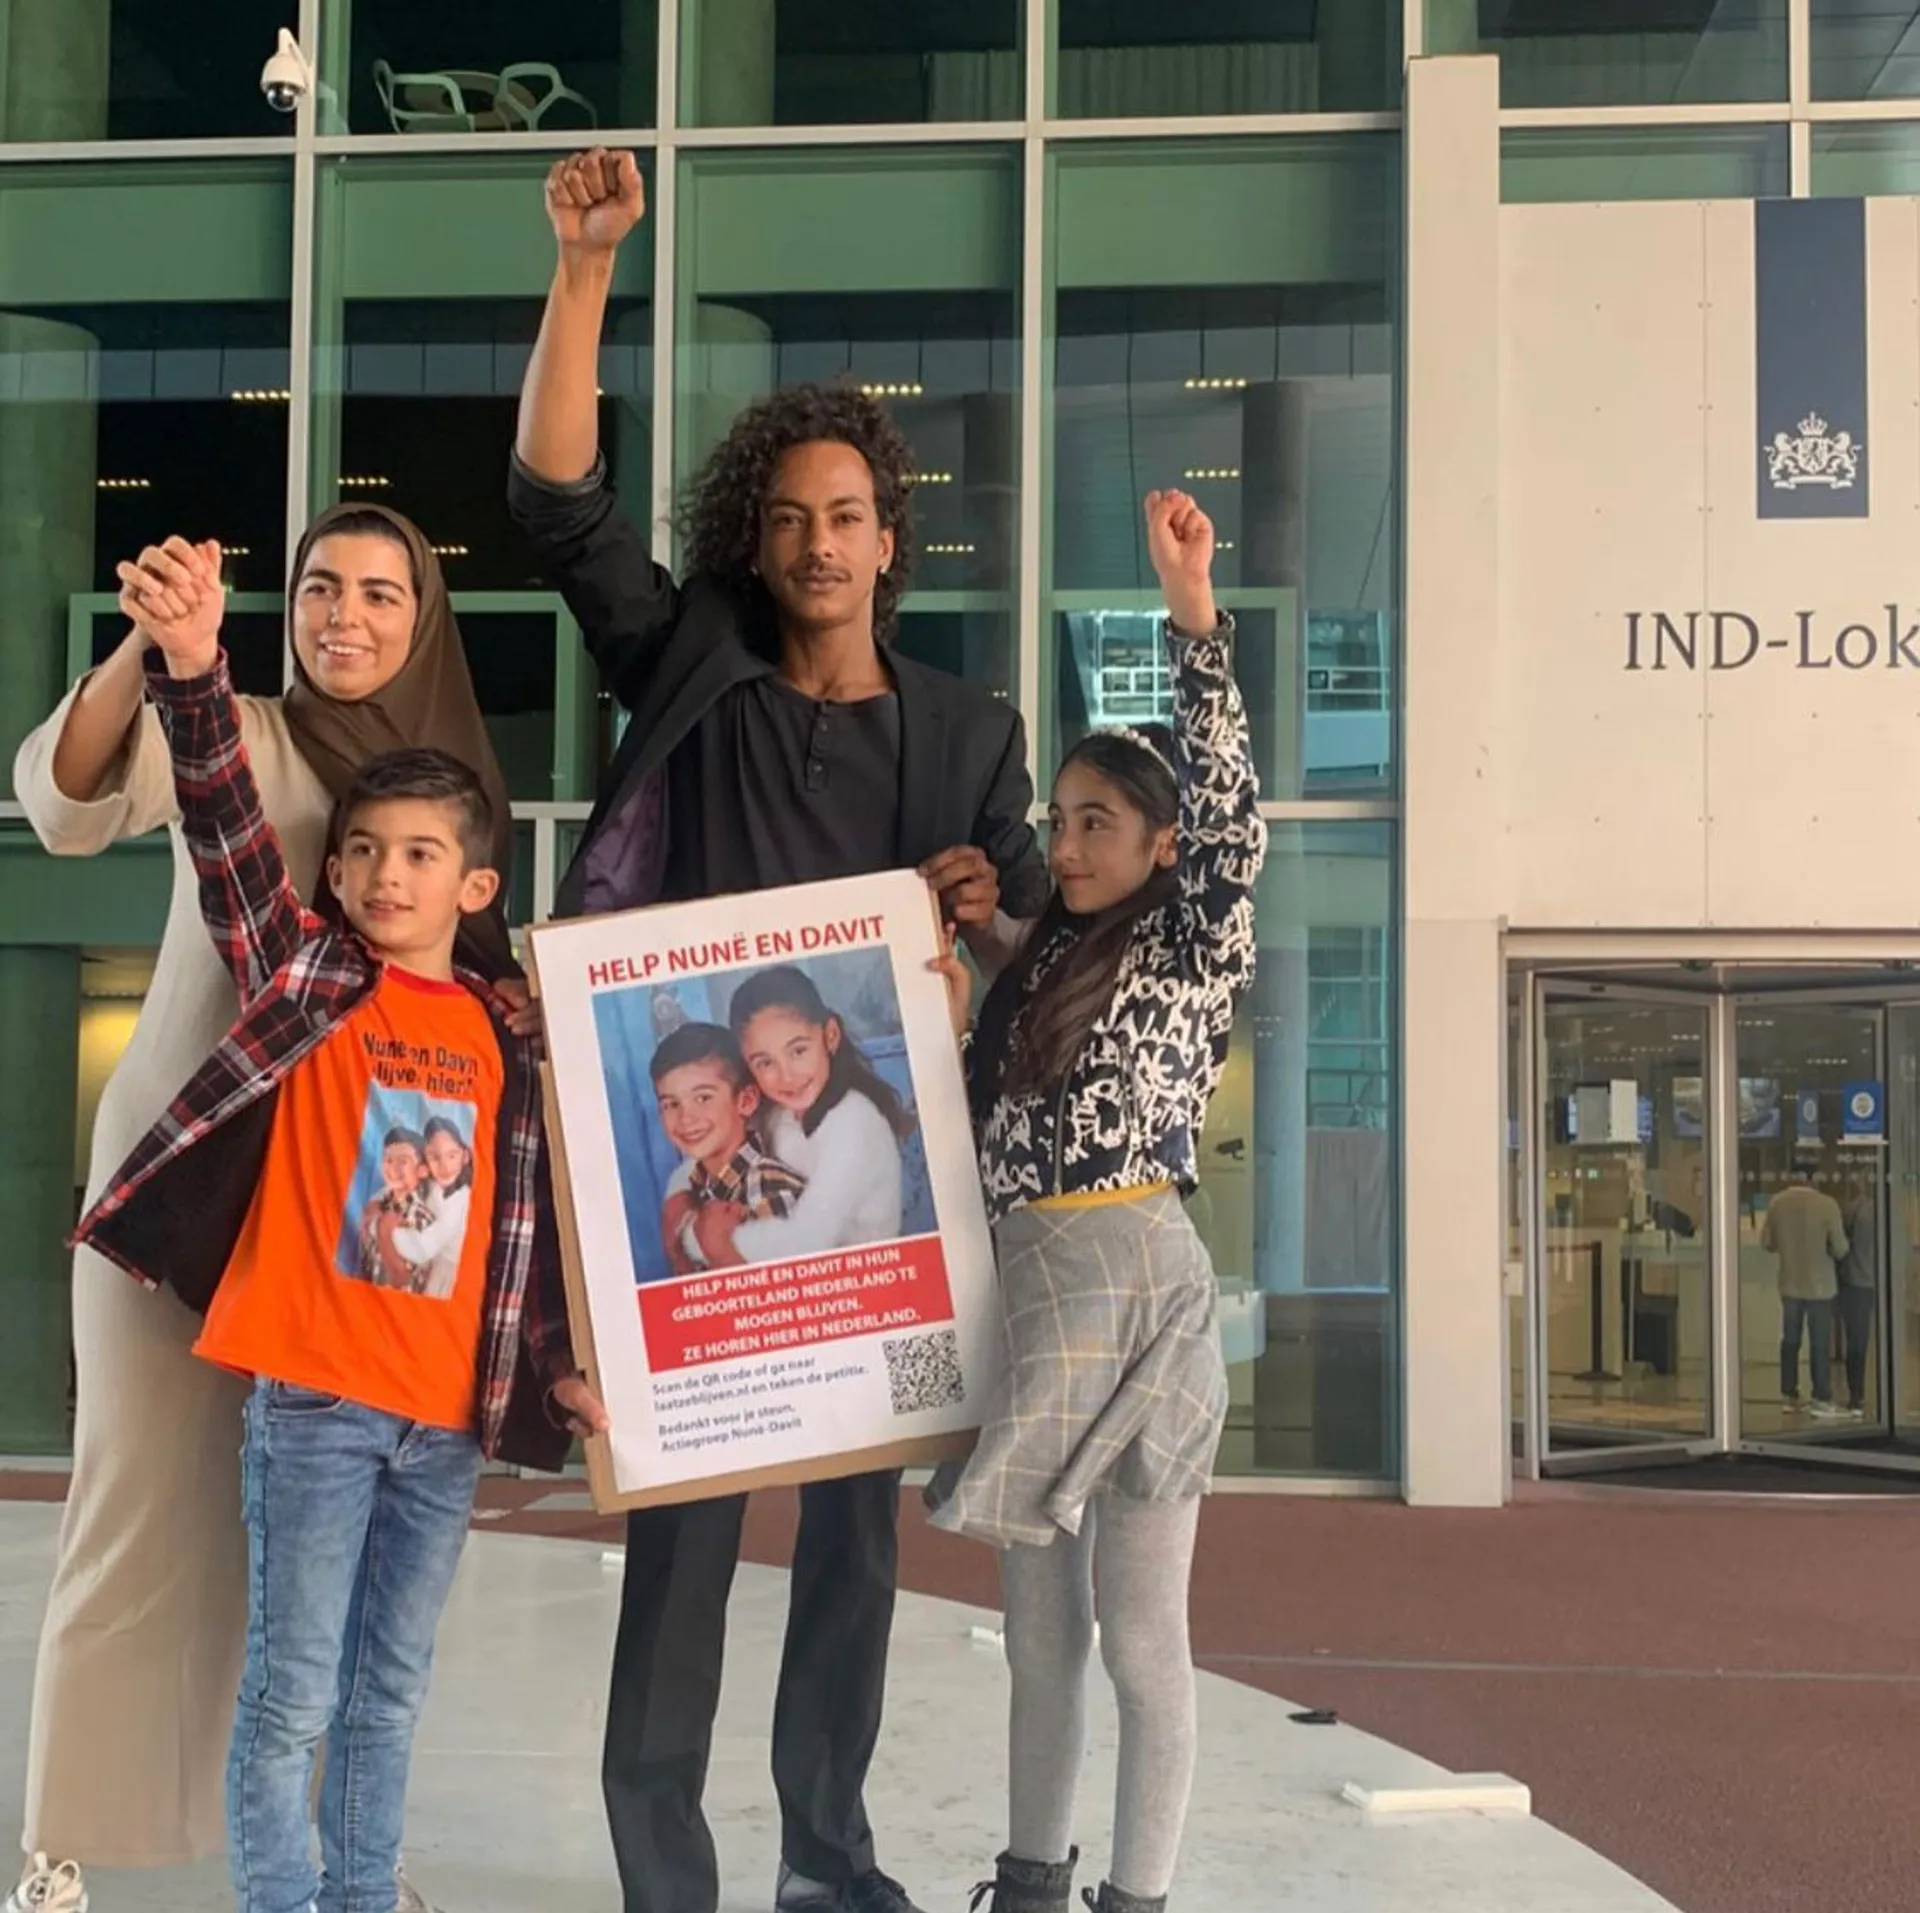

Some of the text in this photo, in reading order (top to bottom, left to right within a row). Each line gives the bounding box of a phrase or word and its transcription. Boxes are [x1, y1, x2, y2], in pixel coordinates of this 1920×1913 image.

[1624, 604, 1920, 671] IND-Lok
[588, 914, 884, 986] HELP NUNË EN DAVIT
[672, 1265, 918, 1322] GEBOORTELAND NEDERLAND TE
[682, 1278, 722, 1300] HELP
[772, 1267, 794, 1284] EN
[796, 1257, 842, 1279] DAVIT
[845, 1254, 863, 1270] IN
[864, 1247, 901, 1267] HUN
[682, 1306, 922, 1362] ZE HOREN HIER IN NEDERLAND.
[734, 1297, 864, 1332] MOGEN BLIJVEN.
[652, 1382, 682, 1396] Scan
[684, 1377, 699, 1389] de
[701, 1373, 720, 1387] QR
[722, 1367, 751, 1382] code
[754, 1362, 768, 1377] of
[788, 1357, 815, 1371] naar
[752, 1383, 768, 1394] en
[769, 1377, 805, 1392] teken
[806, 1373, 822, 1384] de
[824, 1364, 870, 1383] petitie.
[658, 1416, 711, 1437] Bedankt
[712, 1412, 741, 1427] voor
[743, 1409, 755, 1423] je
[661, 1432, 730, 1452] Actiegroep
